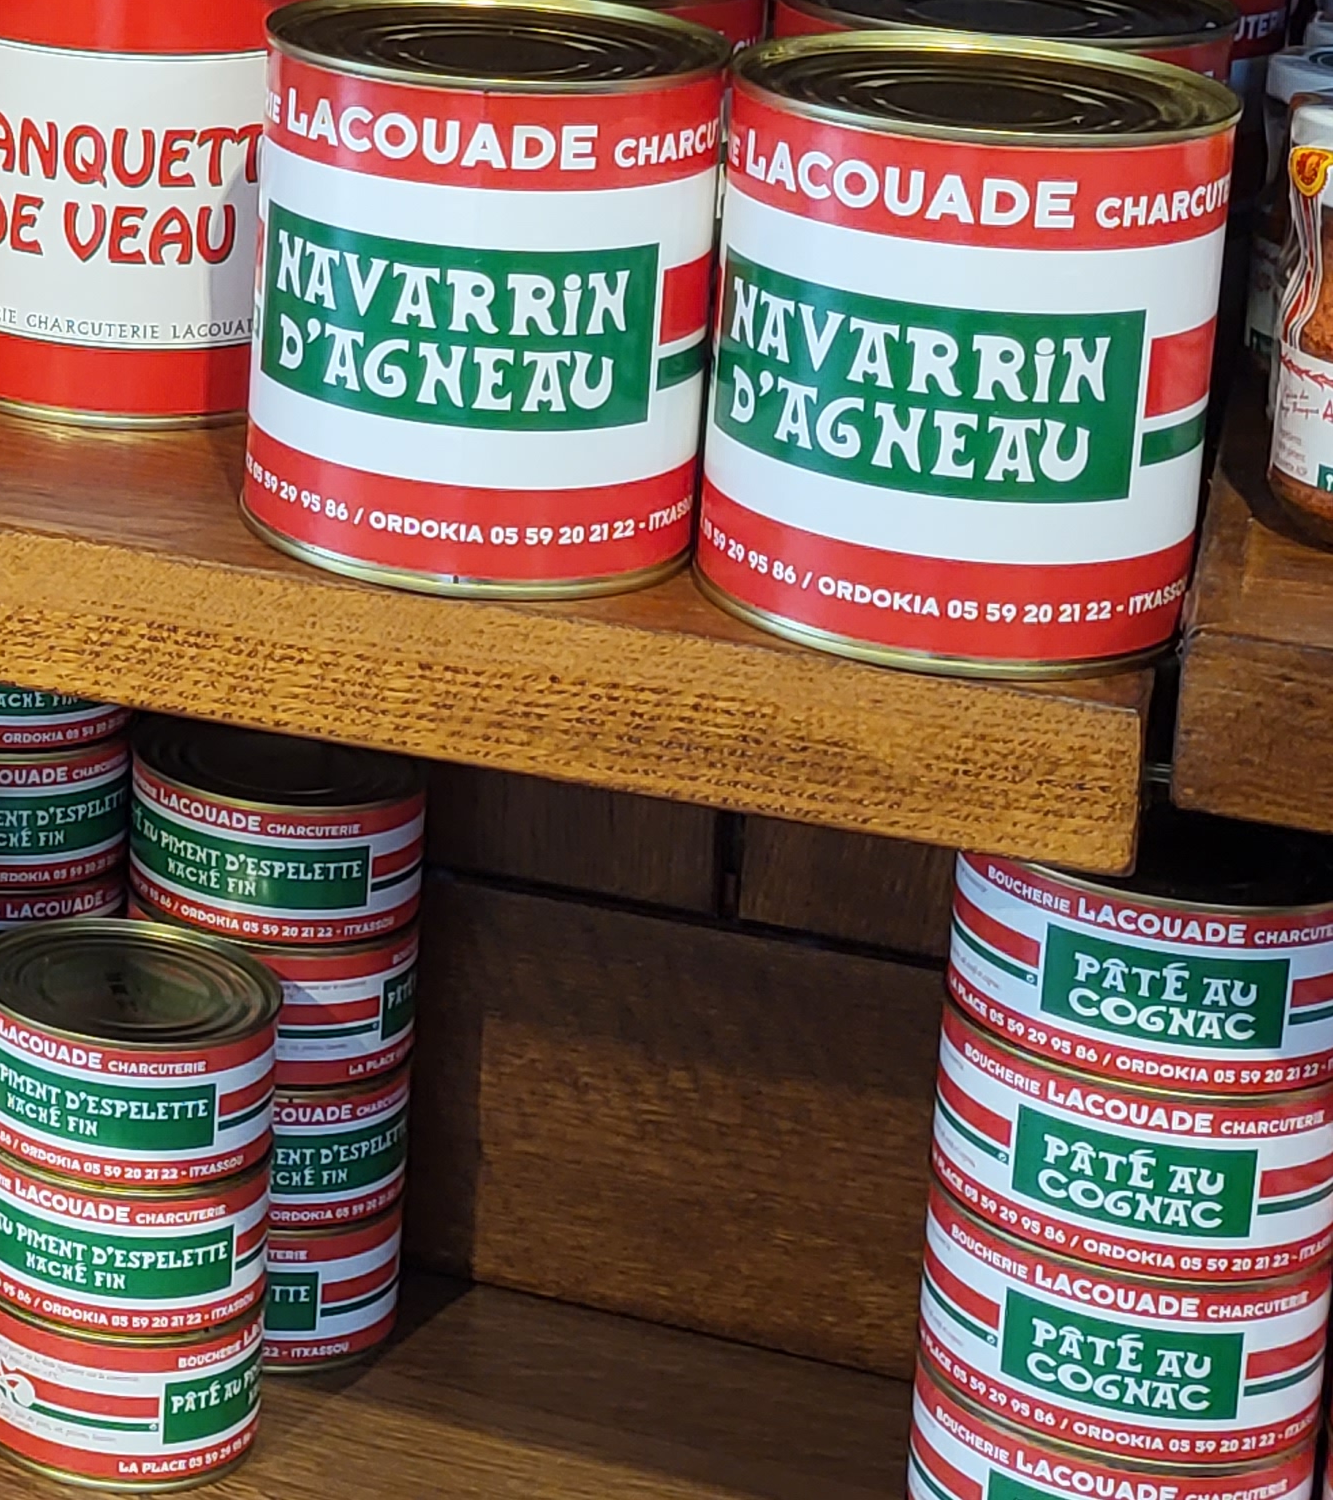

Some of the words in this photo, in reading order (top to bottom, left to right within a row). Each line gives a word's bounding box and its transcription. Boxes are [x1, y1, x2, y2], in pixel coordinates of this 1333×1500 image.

[285, 86, 599, 171] LACOUADE
[745, 133, 1079, 230] LACOUADE
[62, 201, 236, 267] VEAU
[26, 311, 160, 341] CHARCUTERIE
[279, 312, 615, 414] D'AGNEAU
[729, 364, 1092, 485] D'AGNEAU
[728, 538, 746, 563] 29
[747, 549, 769, 574] 95
[771, 561, 798, 586] 86
[817, 575, 941, 620] ORDOKIA
[946, 598, 979, 621] 05
[985, 600, 1018, 623] 59
[1022, 602, 1053, 625] 20
[1057, 600, 1082, 623] 21
[1085, 598, 1113, 621] 22
[986, 863, 1072, 915] BOUCHERIE
[1076, 896, 1247, 945] LACOUADE
[1072, 951, 1193, 1003] PÂTÉ
[1203, 977, 1259, 1008] AU
[988, 1008, 1006, 1030] 05
[1007, 1017, 1026, 1037] 59
[1028, 1025, 1048, 1046] 29
[1051, 1034, 1072, 1056] 95
[1075, 1042, 1099, 1062] 86
[1115, 1054, 1210, 1083] ORDOKIA
[1067, 987, 1257, 1042] COGNAC
[106, 1055, 207, 1075] CHARCUTERIE
[64, 1088, 210, 1121] D'ESPELETTE
[67, 1114, 99, 1139] FIN
[1046, 1079, 1215, 1135] LACOUADE
[1042, 1131, 1159, 1189] PÂTÉ
[1169, 1165, 1227, 1195] AU
[1036, 1167, 1224, 1229] COGNAC
[171, 1382, 221, 1414] PÂTÉ
[224, 1378, 243, 1400] AU
[119, 1461, 139, 1474] LA
[142, 1459, 187, 1474] PLACE
